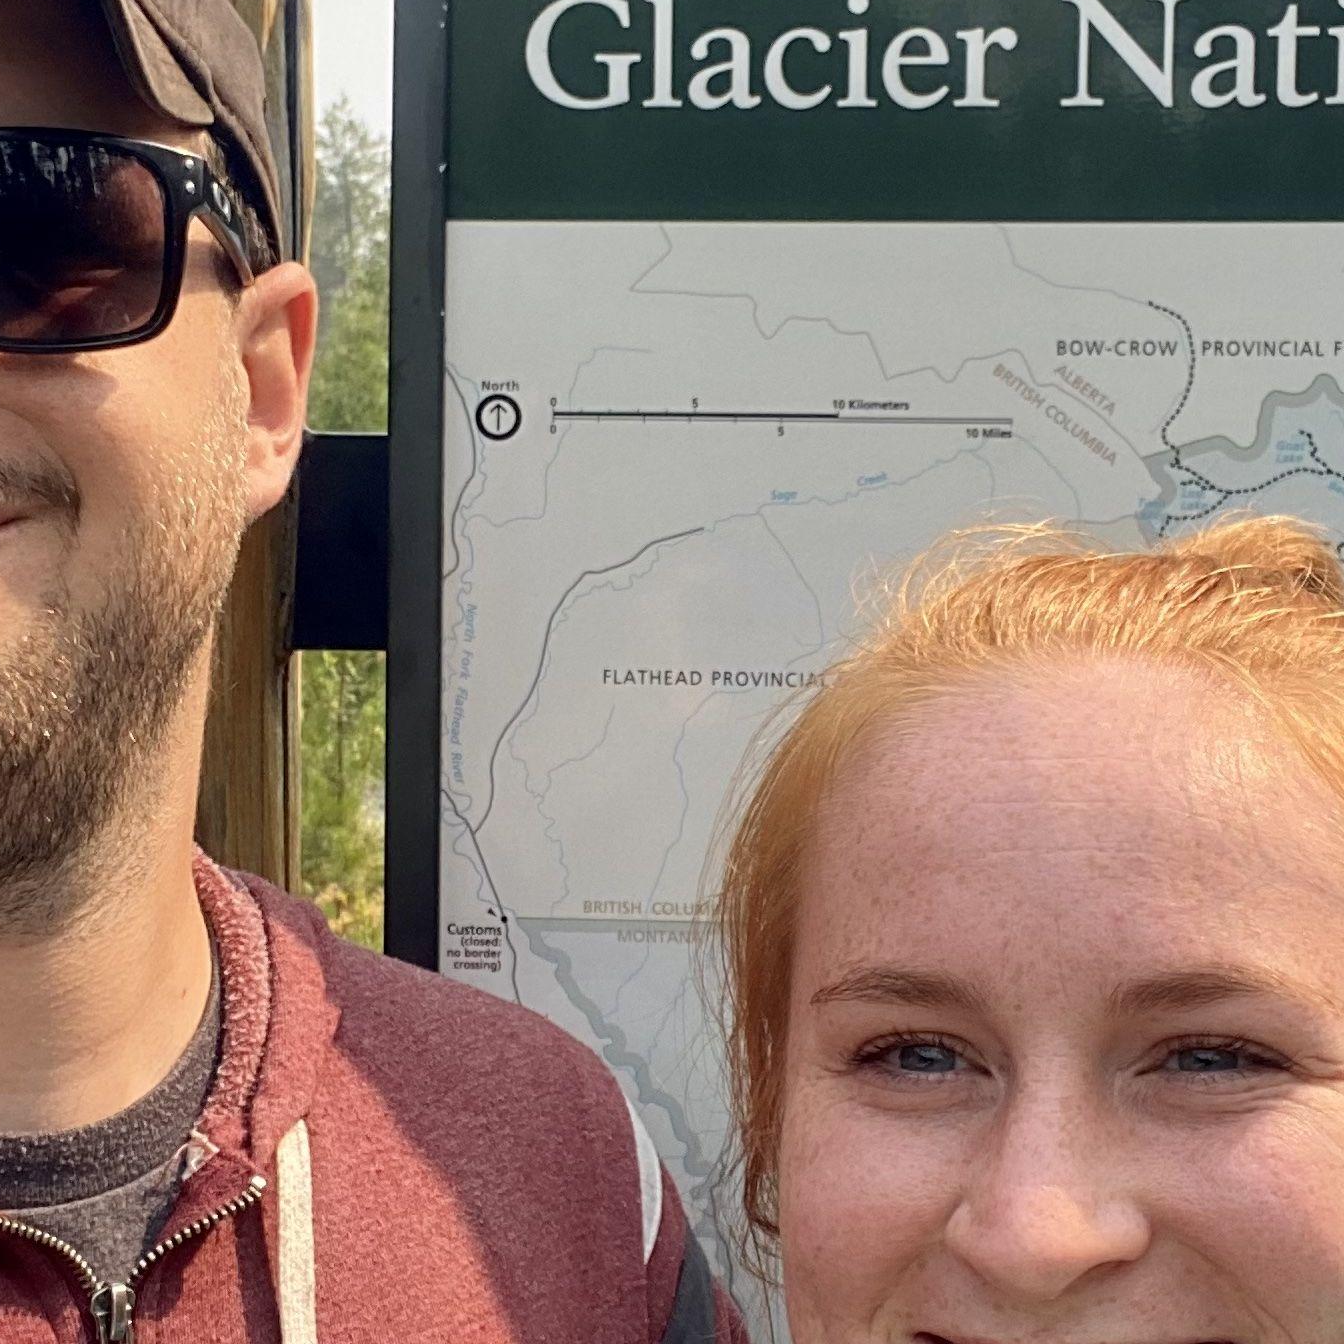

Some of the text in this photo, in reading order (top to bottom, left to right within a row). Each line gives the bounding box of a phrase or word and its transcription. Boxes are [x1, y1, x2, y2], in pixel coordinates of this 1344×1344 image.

[1055, 339, 1179, 357] BOW-CROW
[1201, 340, 1325, 357] PROVINCIAL
[481, 380, 521, 392] North
[1053, 363, 1118, 417] ALBERTA
[550, 397, 557, 408] 0
[691, 397, 699, 408] 5
[832, 399, 910, 411] 10 Kilometers
[991, 362, 1118, 468] BRITISH COLUMBIA
[549, 424, 557, 435] 0
[777, 426, 785, 437] 5
[966, 428, 1013, 439] 10 Miles
[602, 668, 703, 687] FLATHEAD
[447, 924, 503, 937] Customs
[446, 948, 502, 959] no border
[453, 959, 502, 973] crossing)
